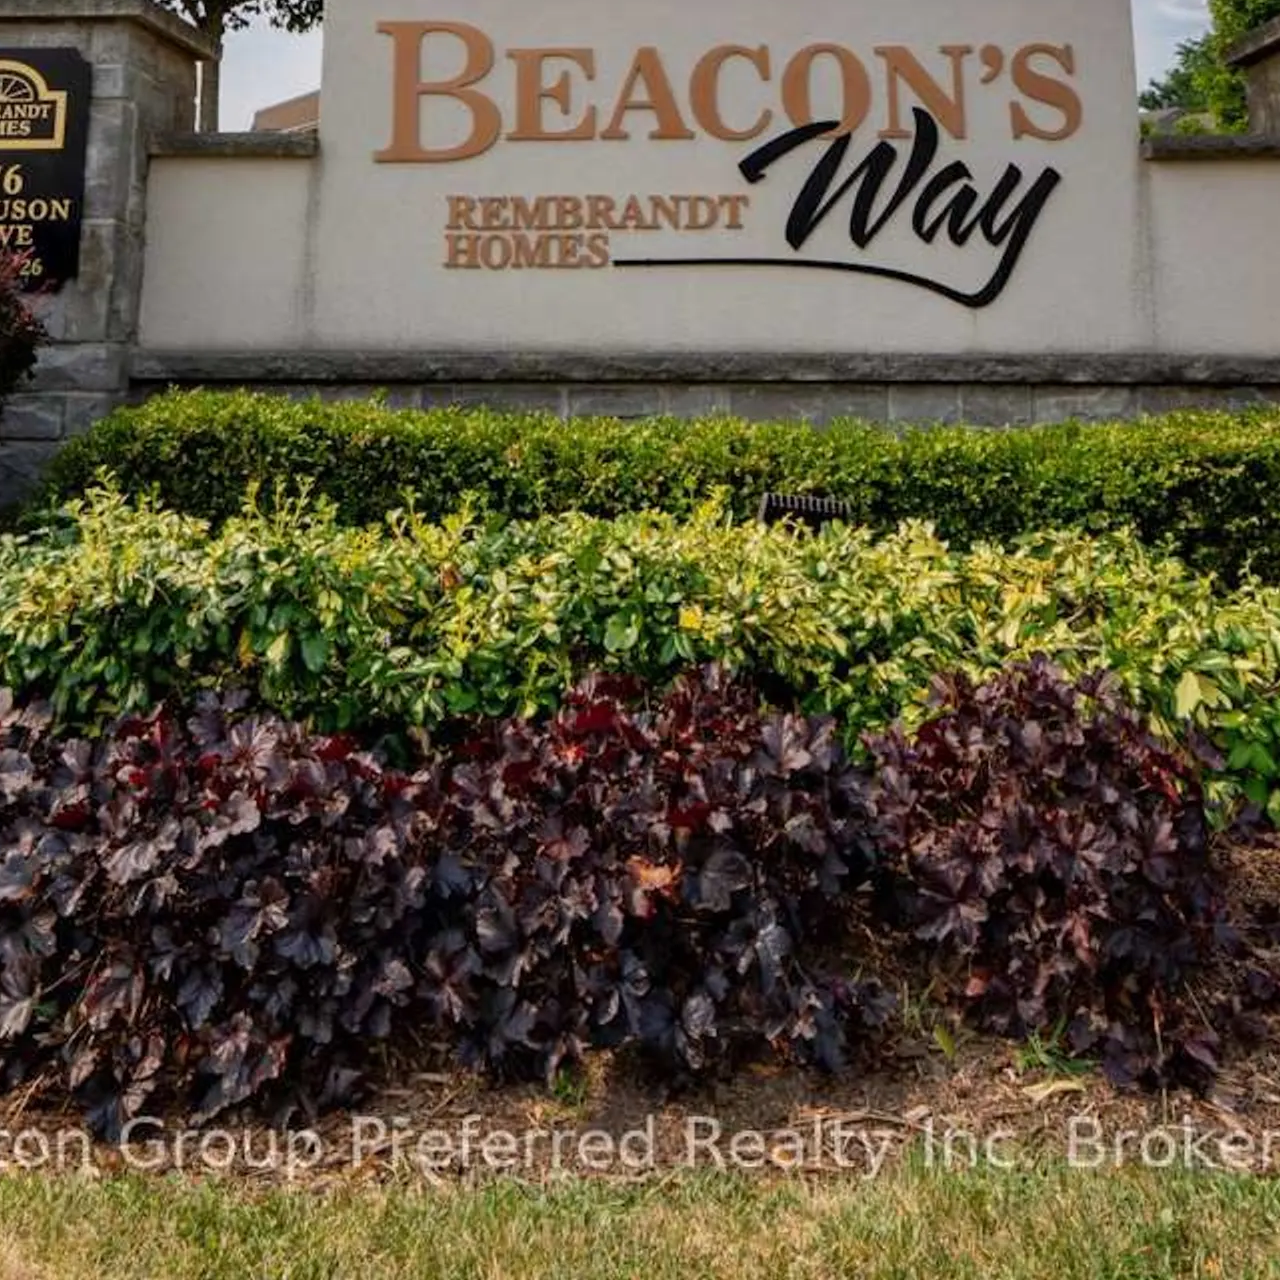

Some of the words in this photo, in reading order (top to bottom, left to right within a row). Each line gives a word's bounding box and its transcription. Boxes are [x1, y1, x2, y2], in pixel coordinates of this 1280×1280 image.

[372, 21, 1083, 164] BEACON'S
[443, 234, 611, 269] HOMES
[445, 195, 749, 232] REMBRANDT
[738, 106, 1061, 308] Way
